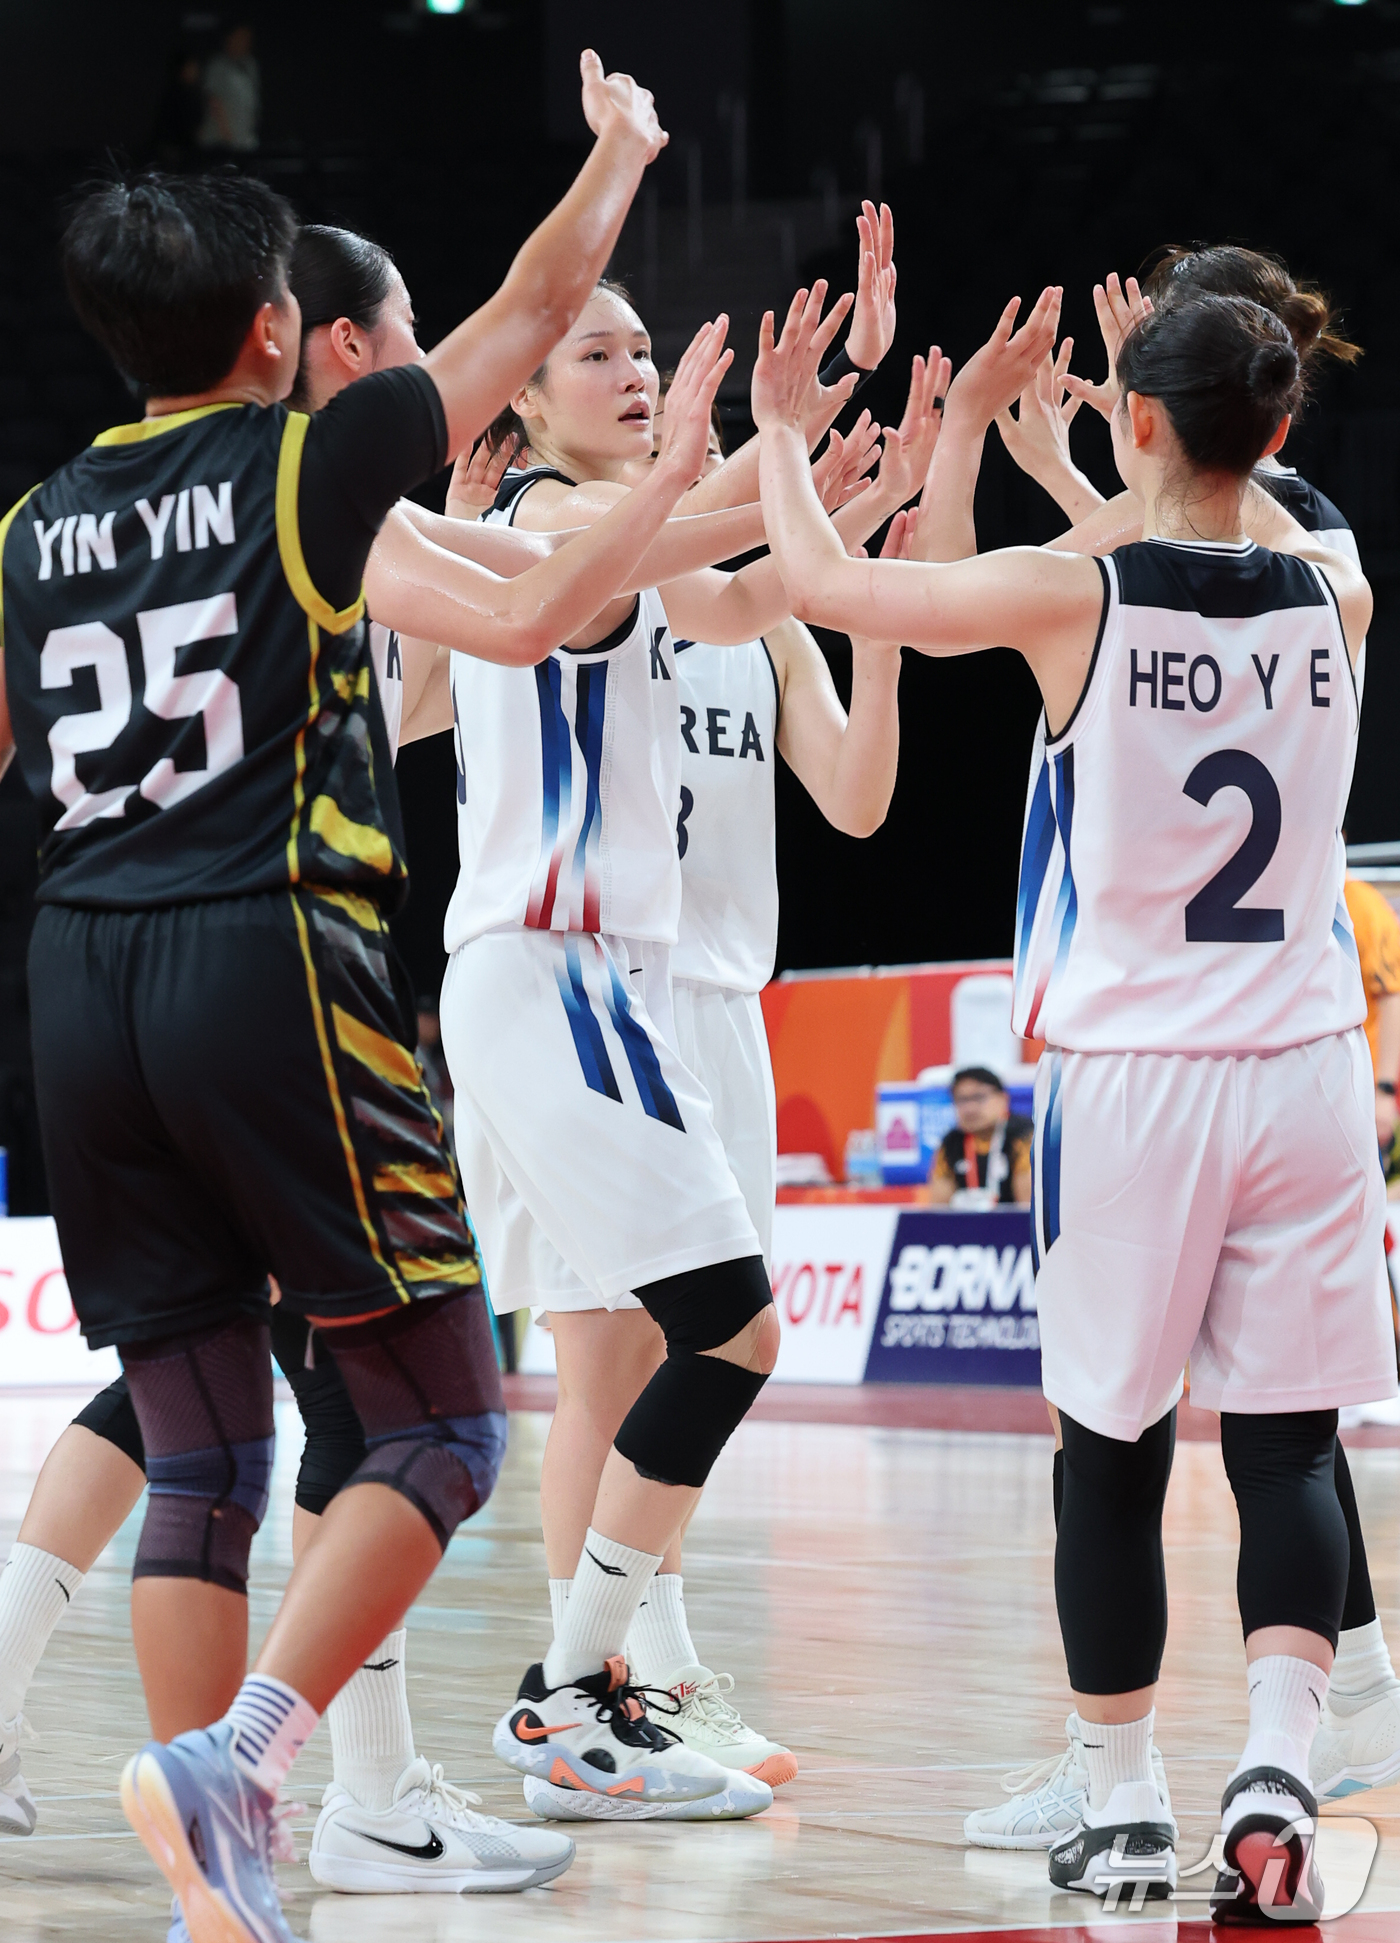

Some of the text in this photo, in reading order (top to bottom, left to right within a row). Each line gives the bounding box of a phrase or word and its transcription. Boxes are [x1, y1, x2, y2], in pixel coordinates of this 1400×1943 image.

[33, 481, 236, 581] YIN YIN
[40, 592, 244, 831] 25
[1129, 648, 1222, 713] HEO
[1182, 749, 1285, 942] 2
